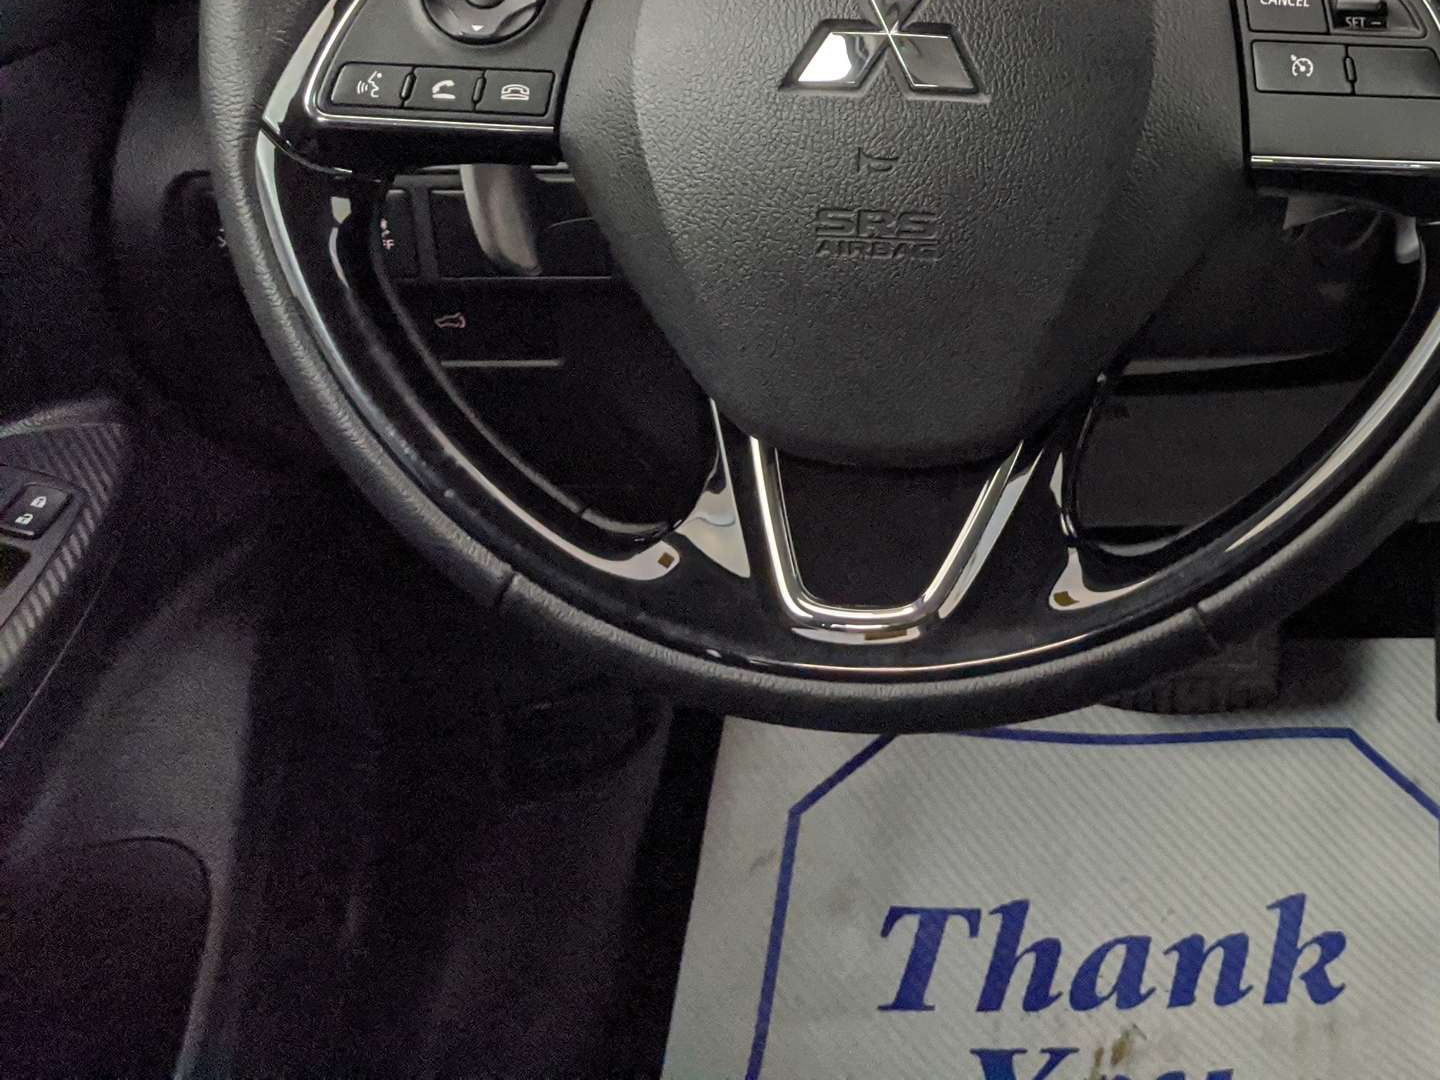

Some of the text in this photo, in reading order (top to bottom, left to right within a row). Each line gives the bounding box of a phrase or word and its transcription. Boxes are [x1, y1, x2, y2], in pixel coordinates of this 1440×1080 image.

[1345, 16, 1367, 29] SET
[815, 208, 942, 237] SRS
[877, 893, 1348, 1014] Thank
